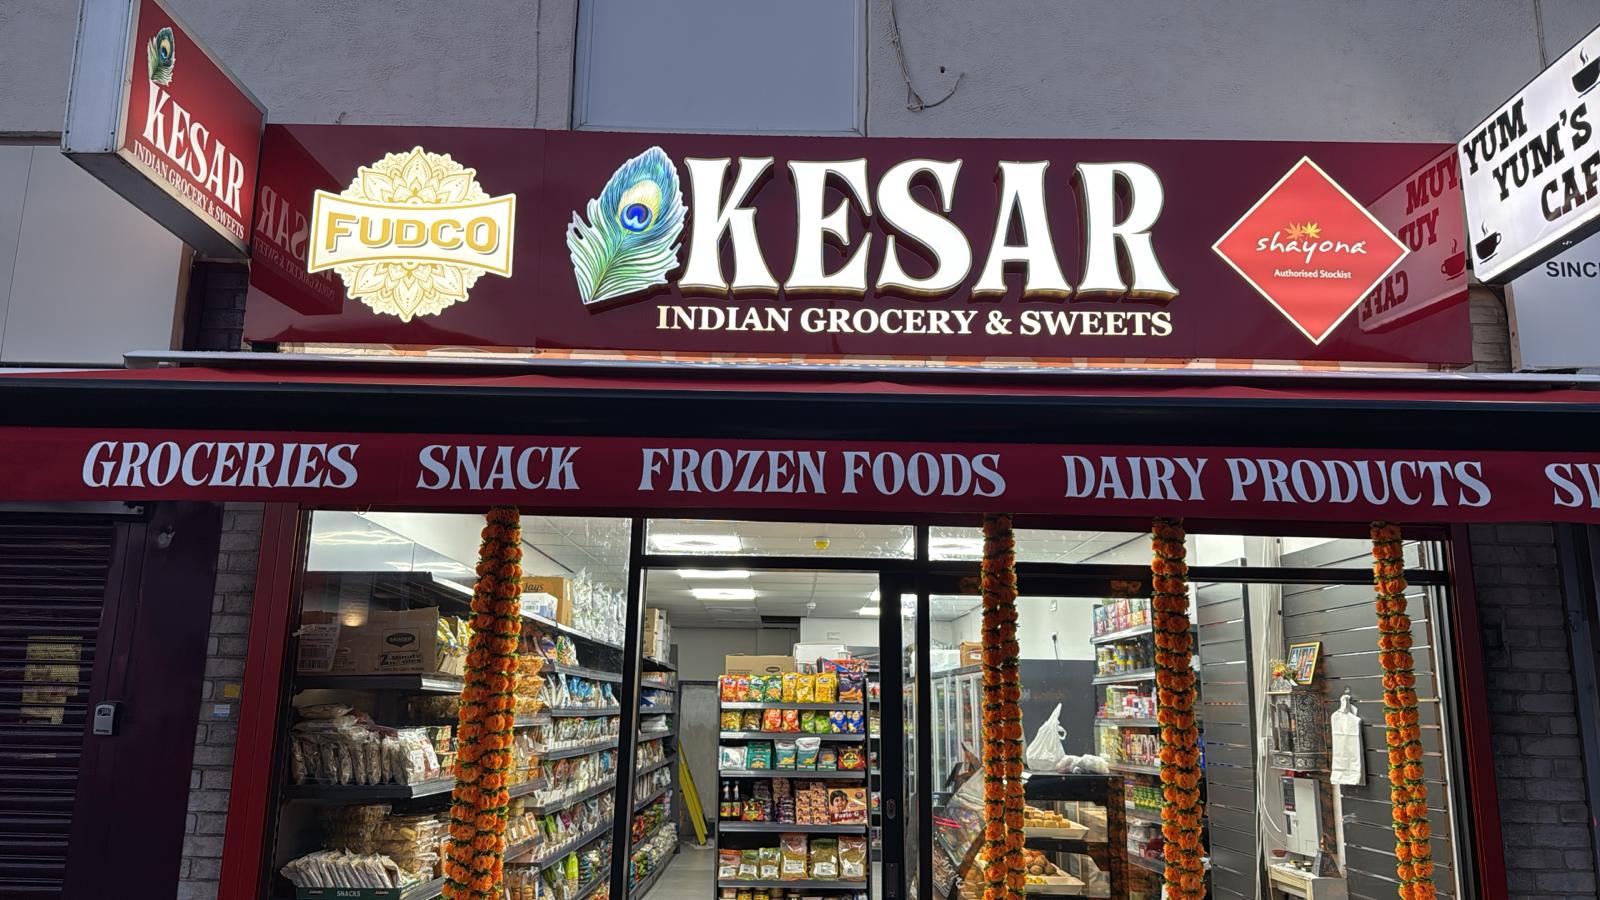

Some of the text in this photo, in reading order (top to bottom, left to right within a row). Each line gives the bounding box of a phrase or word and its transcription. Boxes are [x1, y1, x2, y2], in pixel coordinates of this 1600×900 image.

[143, 80, 245, 218] KESAR
[1463, 97, 1528, 176] YUM
[1492, 101, 1593, 202] YUM'S
[134, 139, 245, 240] INDIAN GROCERY & SWEETS
[325, 211, 499, 255] FUDCO
[679, 157, 1179, 295] KESAR
[1256, 231, 1367, 264] shayona
[1274, 269, 1352, 279] Authorised Stockist
[1546, 261, 1600, 278] SINC
[656, 305, 1173, 337] INDIAN GROCERY & SWEETS
[82, 441, 360, 488] GROCERIES
[416, 444, 581, 490] SNACK
[639, 448, 1006, 497] FROZEN FOODS
[1062, 455, 1491, 507] DAIRY PRODUCTS
